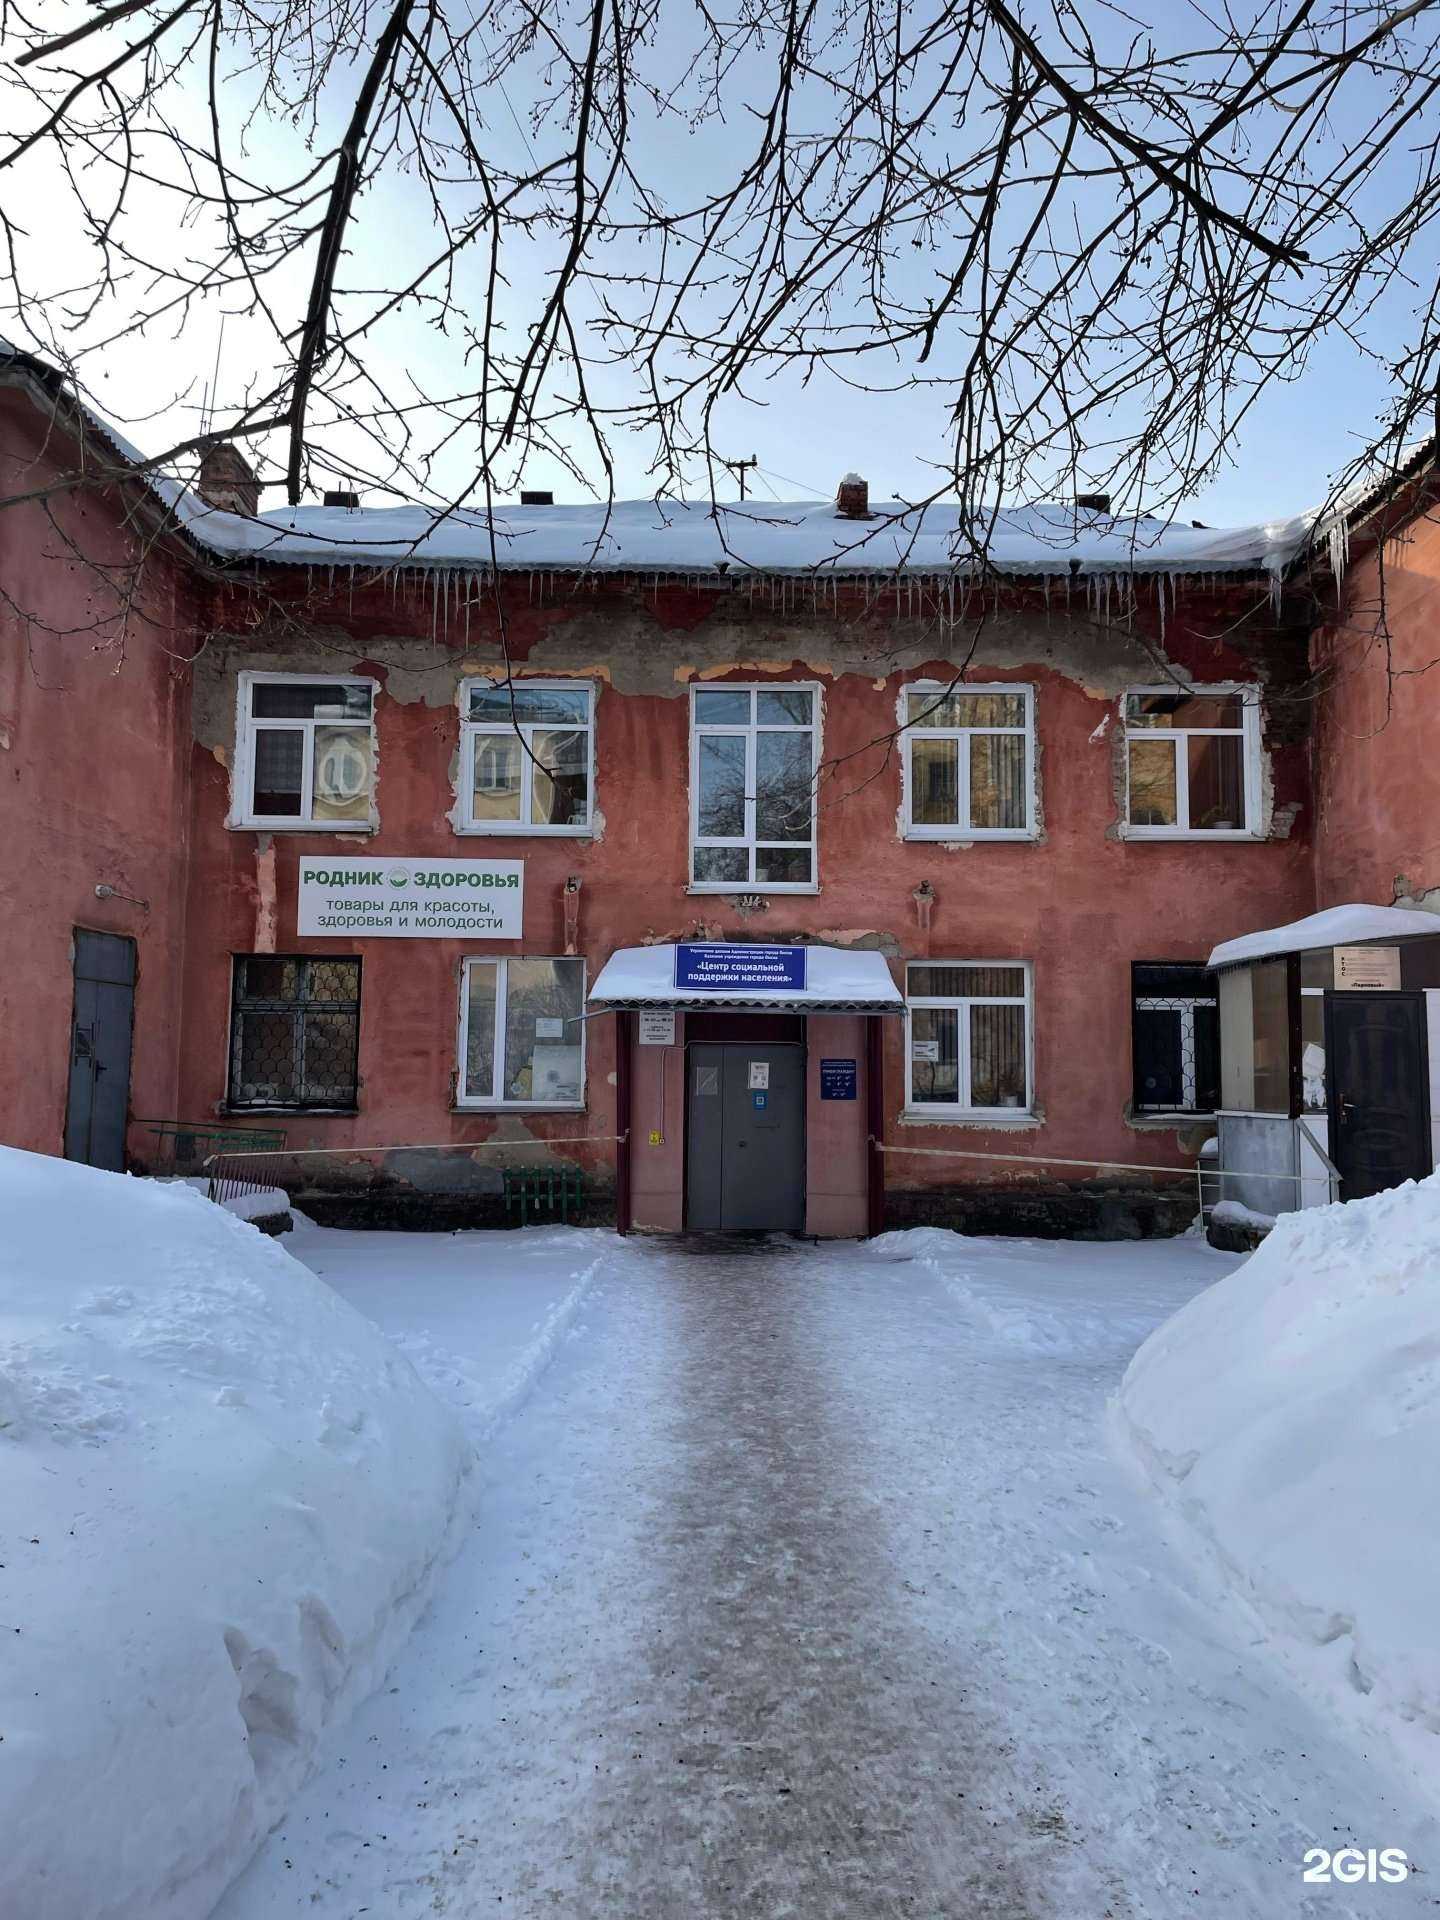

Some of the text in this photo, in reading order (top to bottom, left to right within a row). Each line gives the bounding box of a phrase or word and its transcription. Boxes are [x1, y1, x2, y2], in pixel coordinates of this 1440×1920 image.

[304, 870, 519, 888] РОДНИК ЗДОРОВЬЯ
[326, 899, 495, 915] товары для красоты,
[318, 915, 503, 929] здоровья и молодости
[697, 962, 785, 972] «Центр социальной
[688, 973, 792, 982] поддержки населения»
